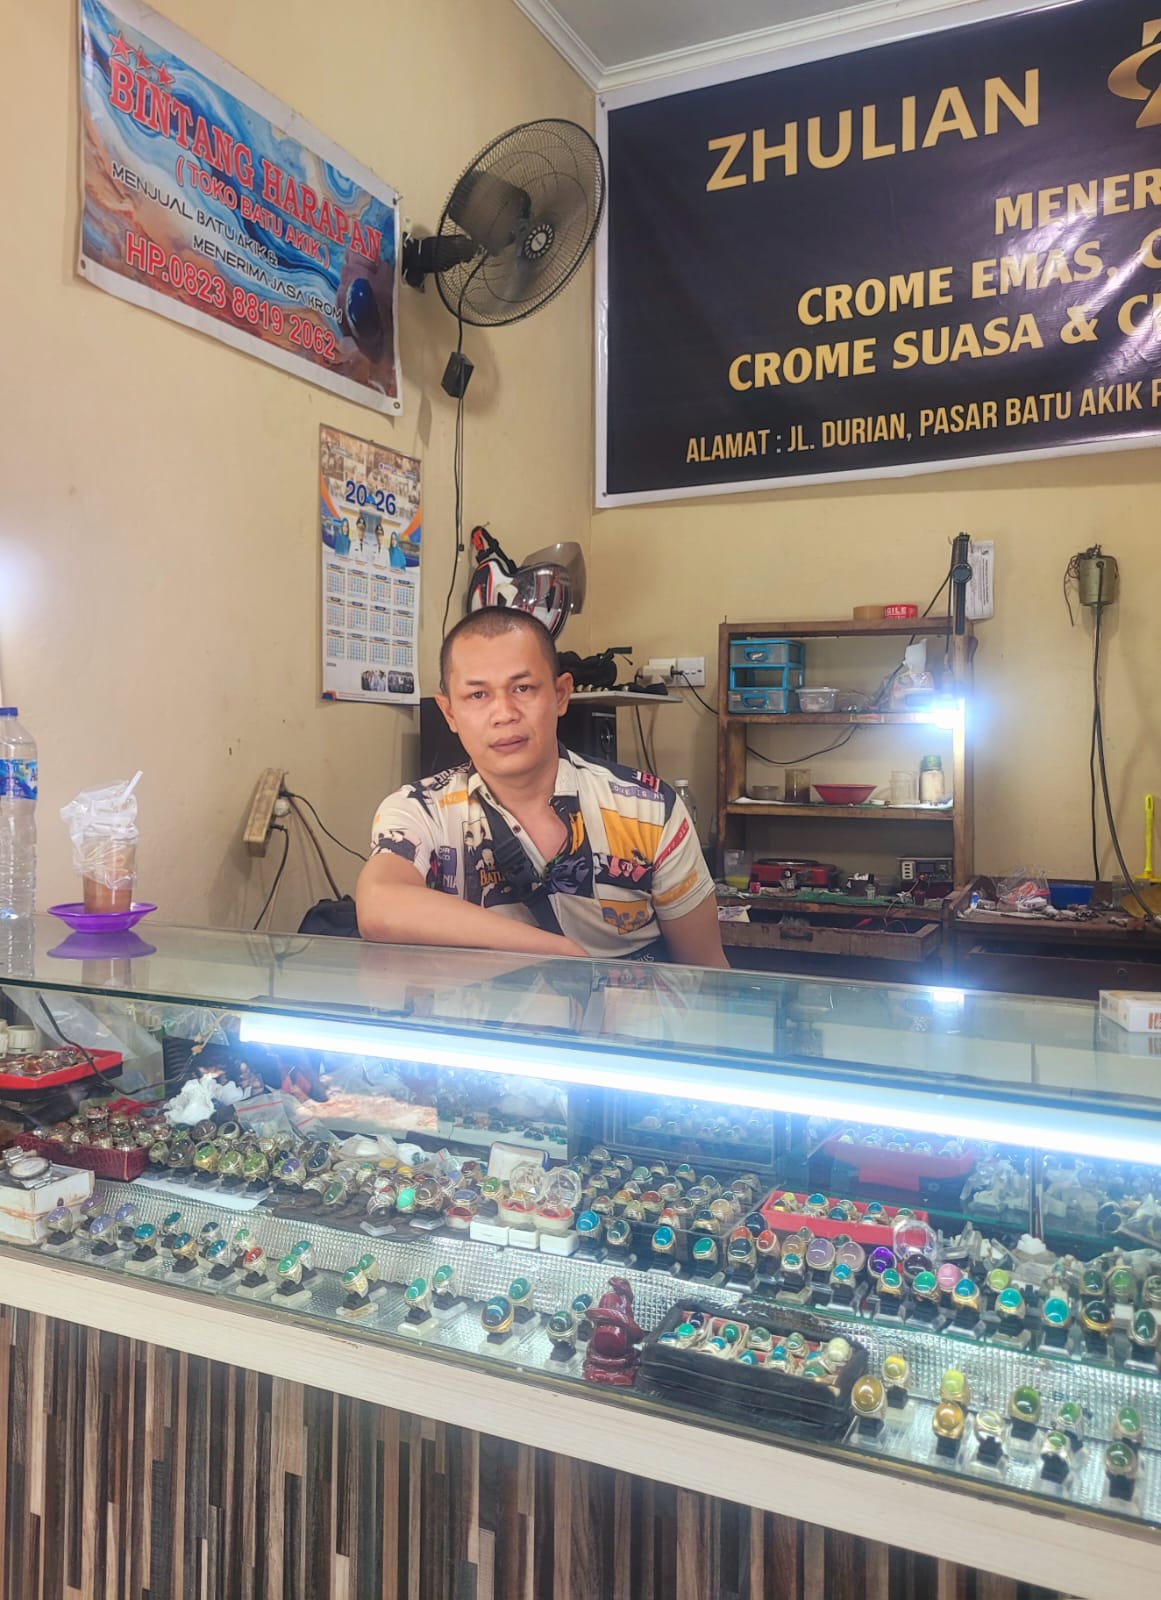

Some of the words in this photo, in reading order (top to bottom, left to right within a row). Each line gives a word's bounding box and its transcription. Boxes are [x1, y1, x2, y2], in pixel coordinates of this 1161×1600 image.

[109, 57, 254, 190] BINTANG
[262, 159, 382, 262] HARAPAN
[706, 69, 1040, 192] ZHULIAN
[112, 162, 193, 220] MENJUAL
[197, 210, 235, 241] BATU
[187, 161, 237, 210] TOKO
[241, 196, 283, 237] BATU
[285, 224, 322, 262] AKIK
[127, 231, 225, 308] HP.0823
[232, 287, 284, 335] 8819
[289, 314, 336, 360] 2062
[194, 234, 269, 285] MENERIMA
[270, 279, 305, 303] JASA
[307, 294, 343, 323] KROM
[797, 266, 954, 327] CROME
[971, 240, 1118, 298] EMAS,
[728, 337, 877, 392] CROME
[892, 313, 1044, 371] SUASA
[1060, 304, 1099, 345] &
[686, 429, 770, 464] ALAMAT
[787, 423, 815, 453] JL.
[822, 412, 912, 448] DURIAN,
[920, 403, 998, 437] PASAR
[1005, 391, 1072, 427] BATU
[1079, 380, 1143, 417] AKIK
